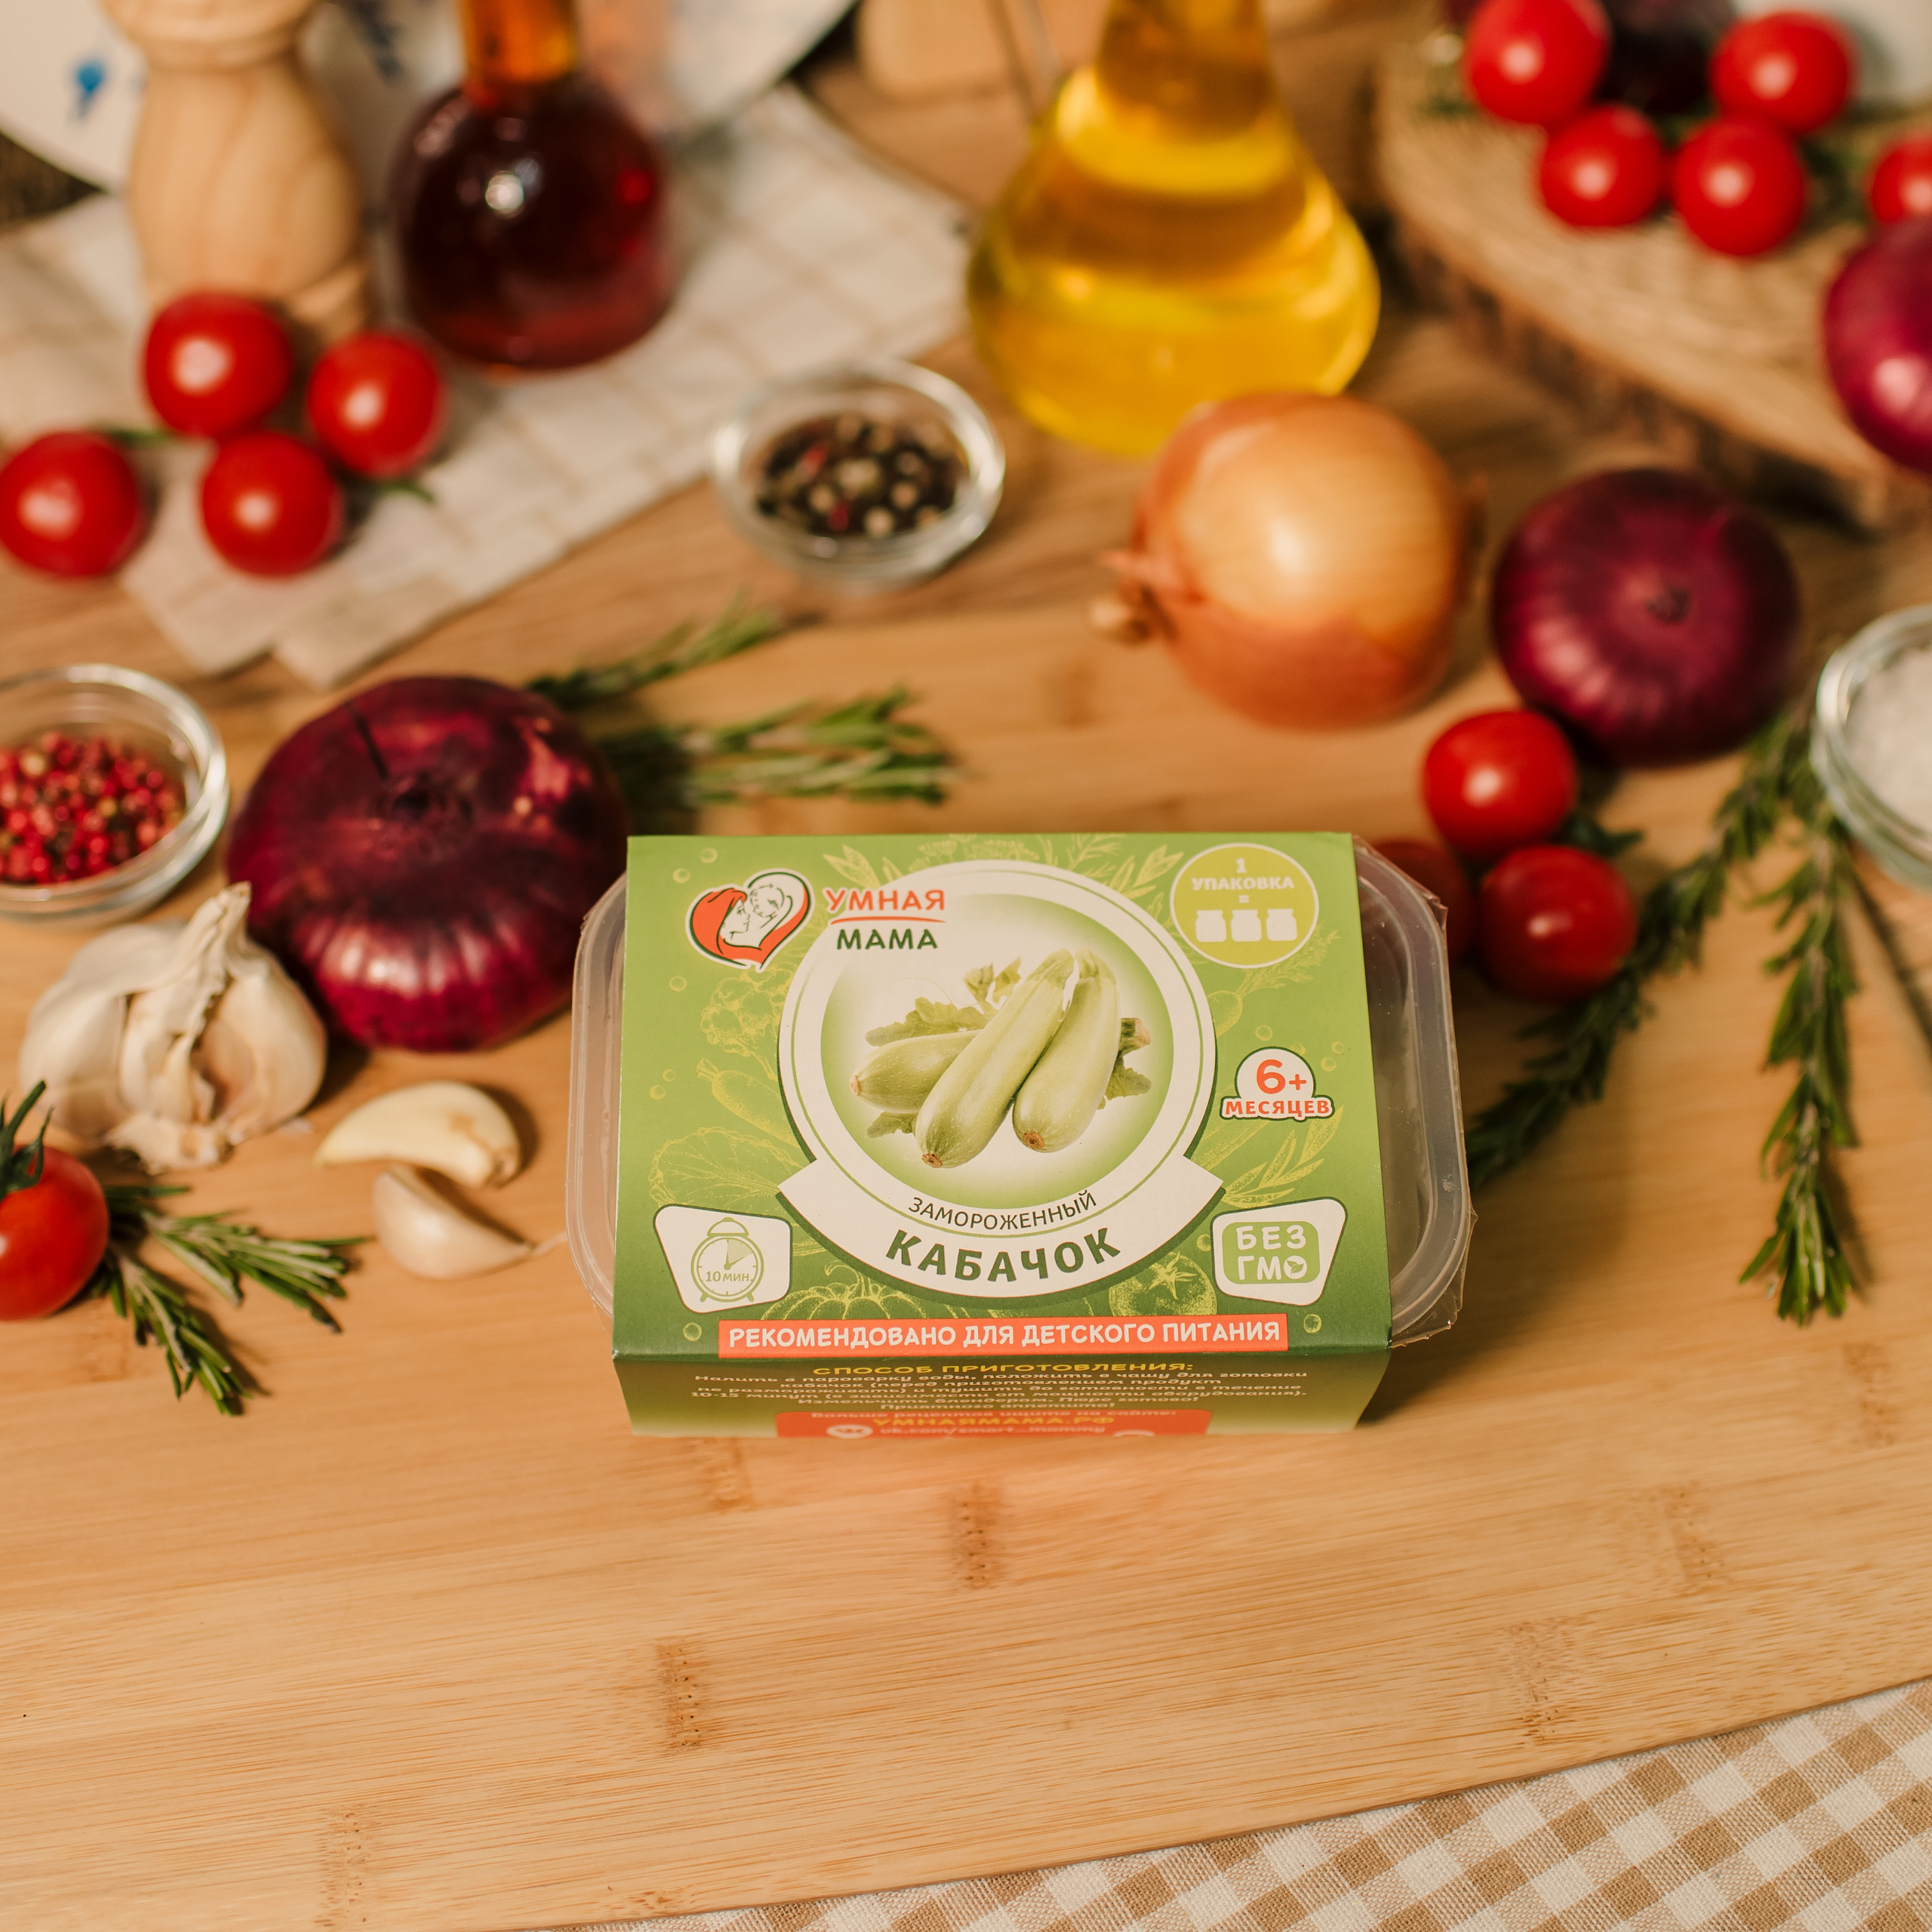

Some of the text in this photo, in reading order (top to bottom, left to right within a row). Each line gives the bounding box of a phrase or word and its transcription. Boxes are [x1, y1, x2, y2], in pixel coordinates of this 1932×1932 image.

[1235, 858, 1247, 874] 1
[1191, 876, 1295, 892] УПАКОВКА
[825, 888, 946, 912] УМНАЯ
[836, 928, 938, 951] МАМА
[1255, 1059, 1307, 1095] 6+
[1225, 1100, 1330, 1118] МЕСЯЦЕВ
[908, 1189, 1097, 1230] ЗАМОРОЖЕННЫЙ
[1238, 1225, 1307, 1251] БЕЗ
[885, 1227, 1121, 1282] КАБАЧОК
[706, 1271, 721, 1282] 10
[1238, 1255, 1308, 1280] ГМО
[729, 1321, 1280, 1349] РЕКОМЕНДОВАНО ДЛЯ ДЕТСКОГО ПИТАНИЯ
[813, 1363, 1193, 1375] СПОСОБ ПРИГОТОВЛЕНИЯ:
[872, 1417, 1115, 1426] УМНАЯМАМА.РФ
